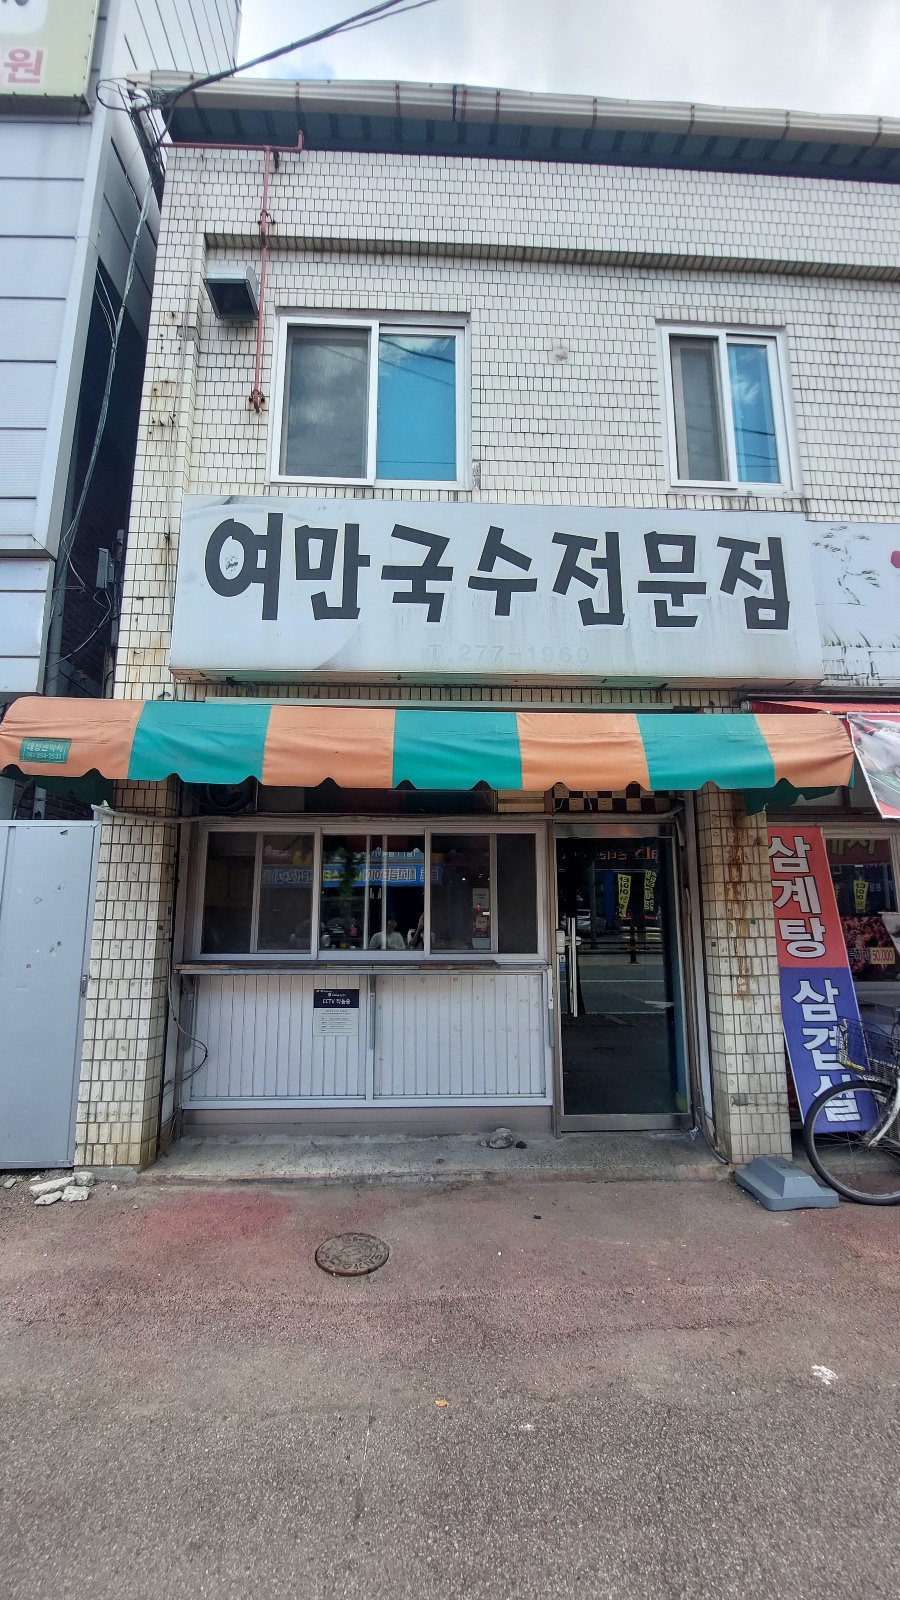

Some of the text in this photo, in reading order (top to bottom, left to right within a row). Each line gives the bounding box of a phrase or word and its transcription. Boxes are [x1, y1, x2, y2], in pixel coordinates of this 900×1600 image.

[4, 49, 43, 83] 원
[204, 512, 789, 630] 여만국수전문점
[427, 643, 590, 664] T.277-1960
[769, 836, 826, 958] 삼계탕
[872, 949, 894, 963] 50,000
